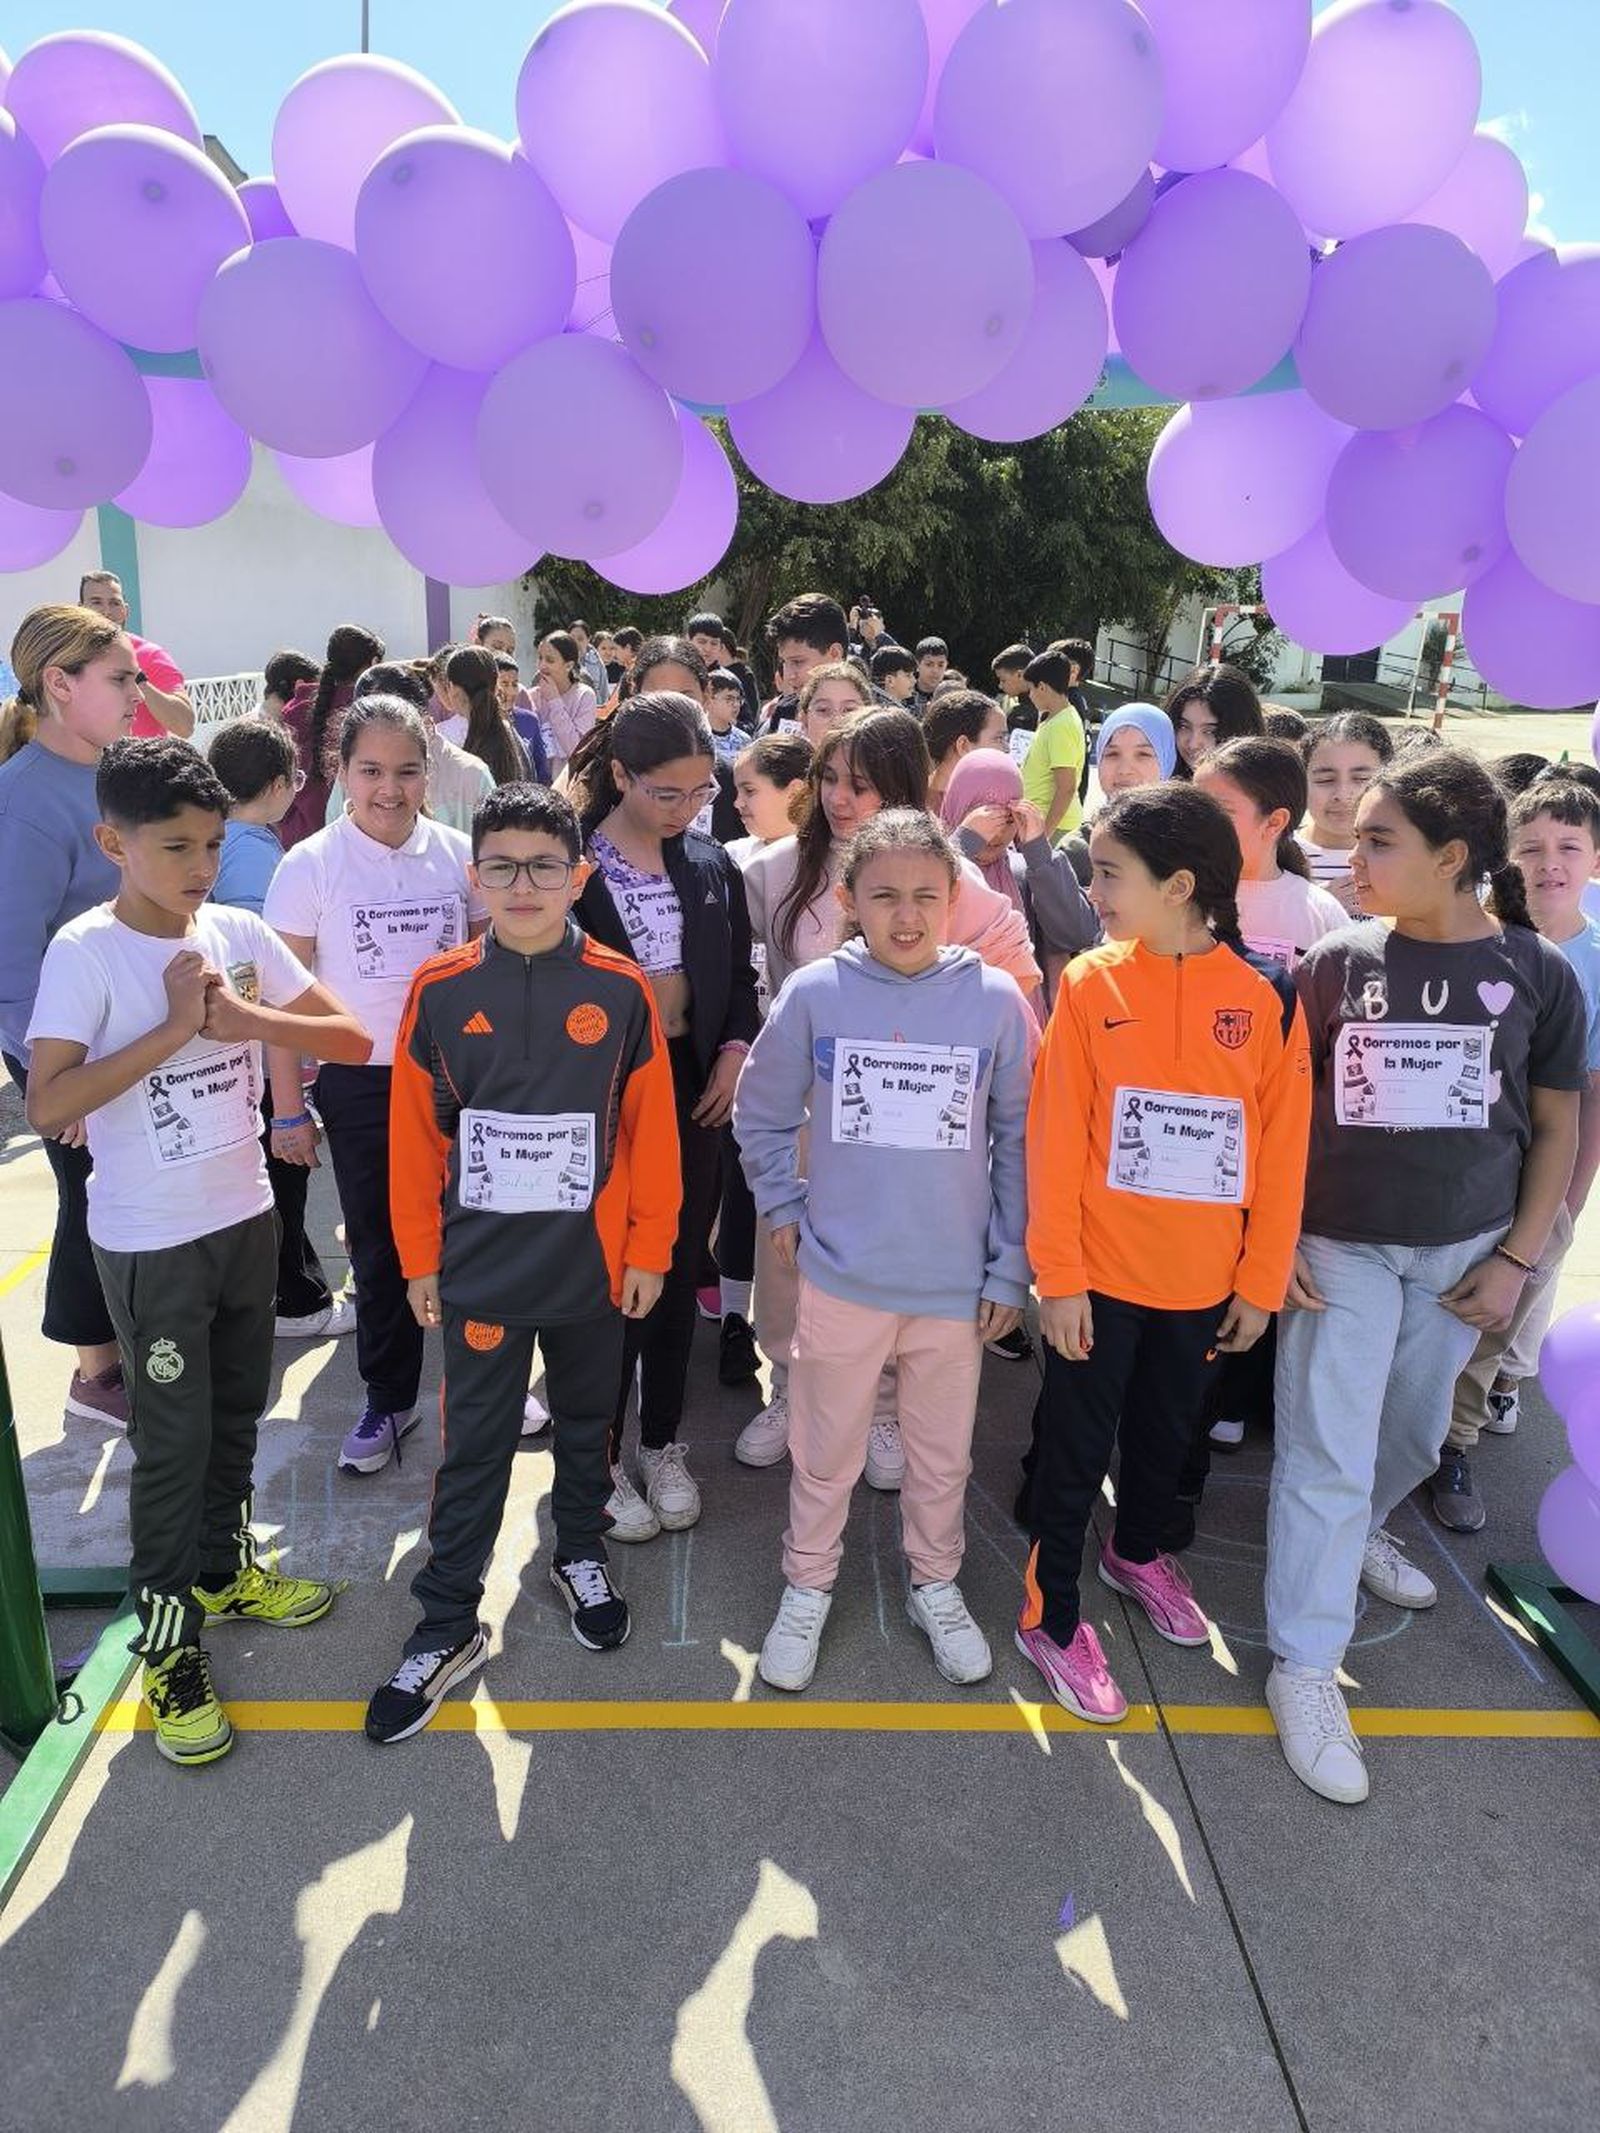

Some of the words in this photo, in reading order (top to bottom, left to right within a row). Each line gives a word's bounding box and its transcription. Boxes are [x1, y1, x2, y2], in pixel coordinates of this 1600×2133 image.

[368, 907, 421, 920] Corremos
[422, 905, 441, 917] por
[387, 924, 398, 934] la
[400, 922, 430, 934] Mujer
[1362, 1036, 1432, 1050] Corremos
[1435, 1037, 1461, 1051] por
[165, 1061, 228, 1086] Corremos
[229, 1054, 244, 1071] por
[862, 1056, 927, 1072] Corremos
[930, 1063, 953, 1079] por
[1384, 1056, 1396, 1069] la
[1400, 1057, 1443, 1072] Mujer
[191, 1088, 205, 1099] la
[207, 1077, 239, 1096] Mujer
[882, 1077, 895, 1090] la
[898, 1079, 936, 1095] Mujer
[1144, 1100, 1208, 1118] Corremos
[485, 1125, 543, 1141] Corremos
[547, 1130, 570, 1142] por
[1163, 1122, 1176, 1136] la
[1179, 1124, 1214, 1141] Mujer
[500, 1147, 511, 1160] la
[515, 1148, 553, 1162] Mujer
